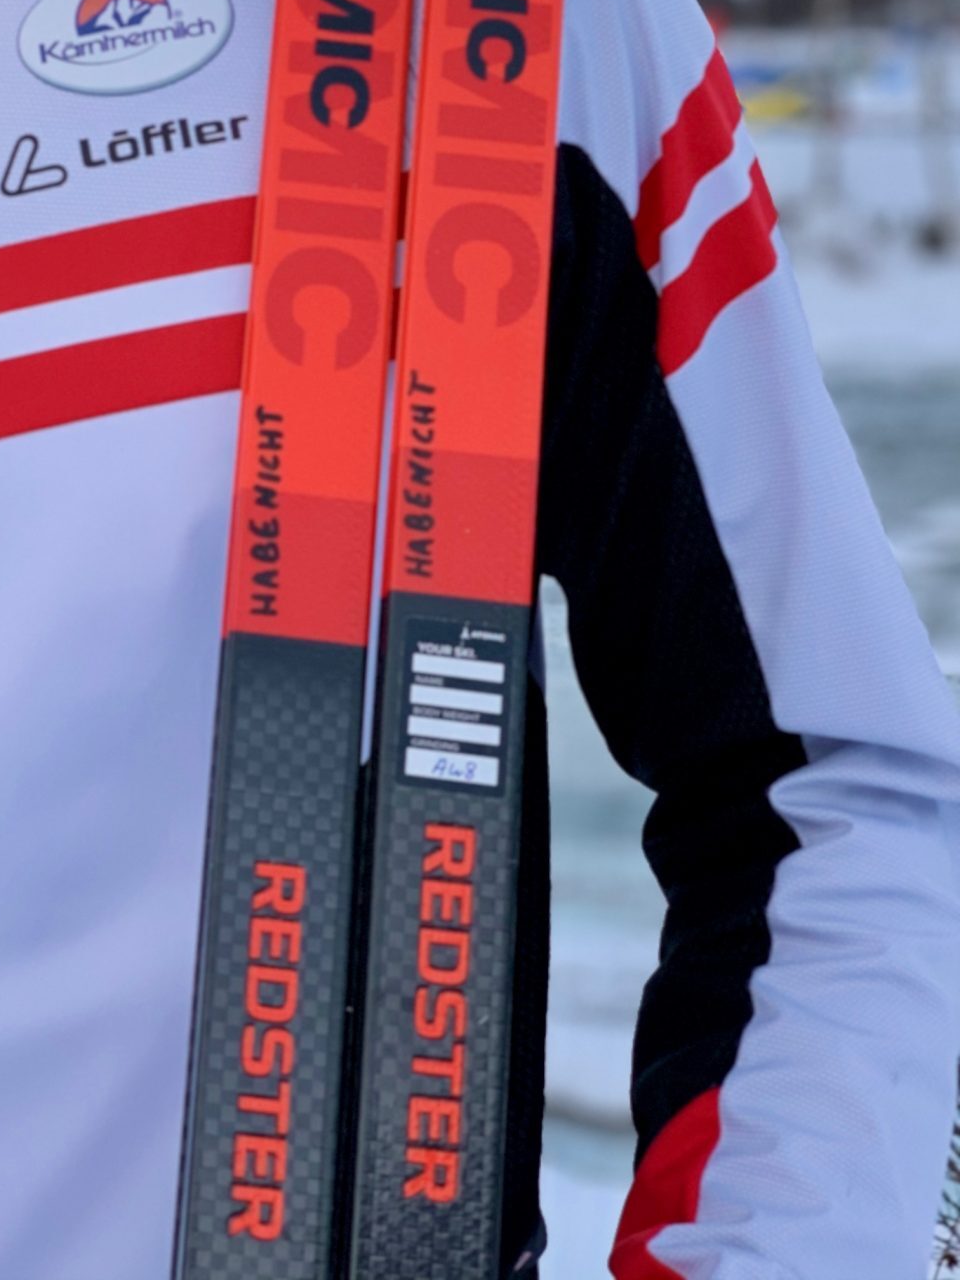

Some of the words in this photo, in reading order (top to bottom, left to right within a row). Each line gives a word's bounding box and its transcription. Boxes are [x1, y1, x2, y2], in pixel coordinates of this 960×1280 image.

[79, 115, 248, 167] Löffler
[248, 404, 284, 616] HABENICHT
[401, 370, 436, 578] HABENICHT
[417, 641, 453, 656] YOUR
[227, 862, 307, 1244] REDSTER
[403, 824, 477, 1206] REDSTER
